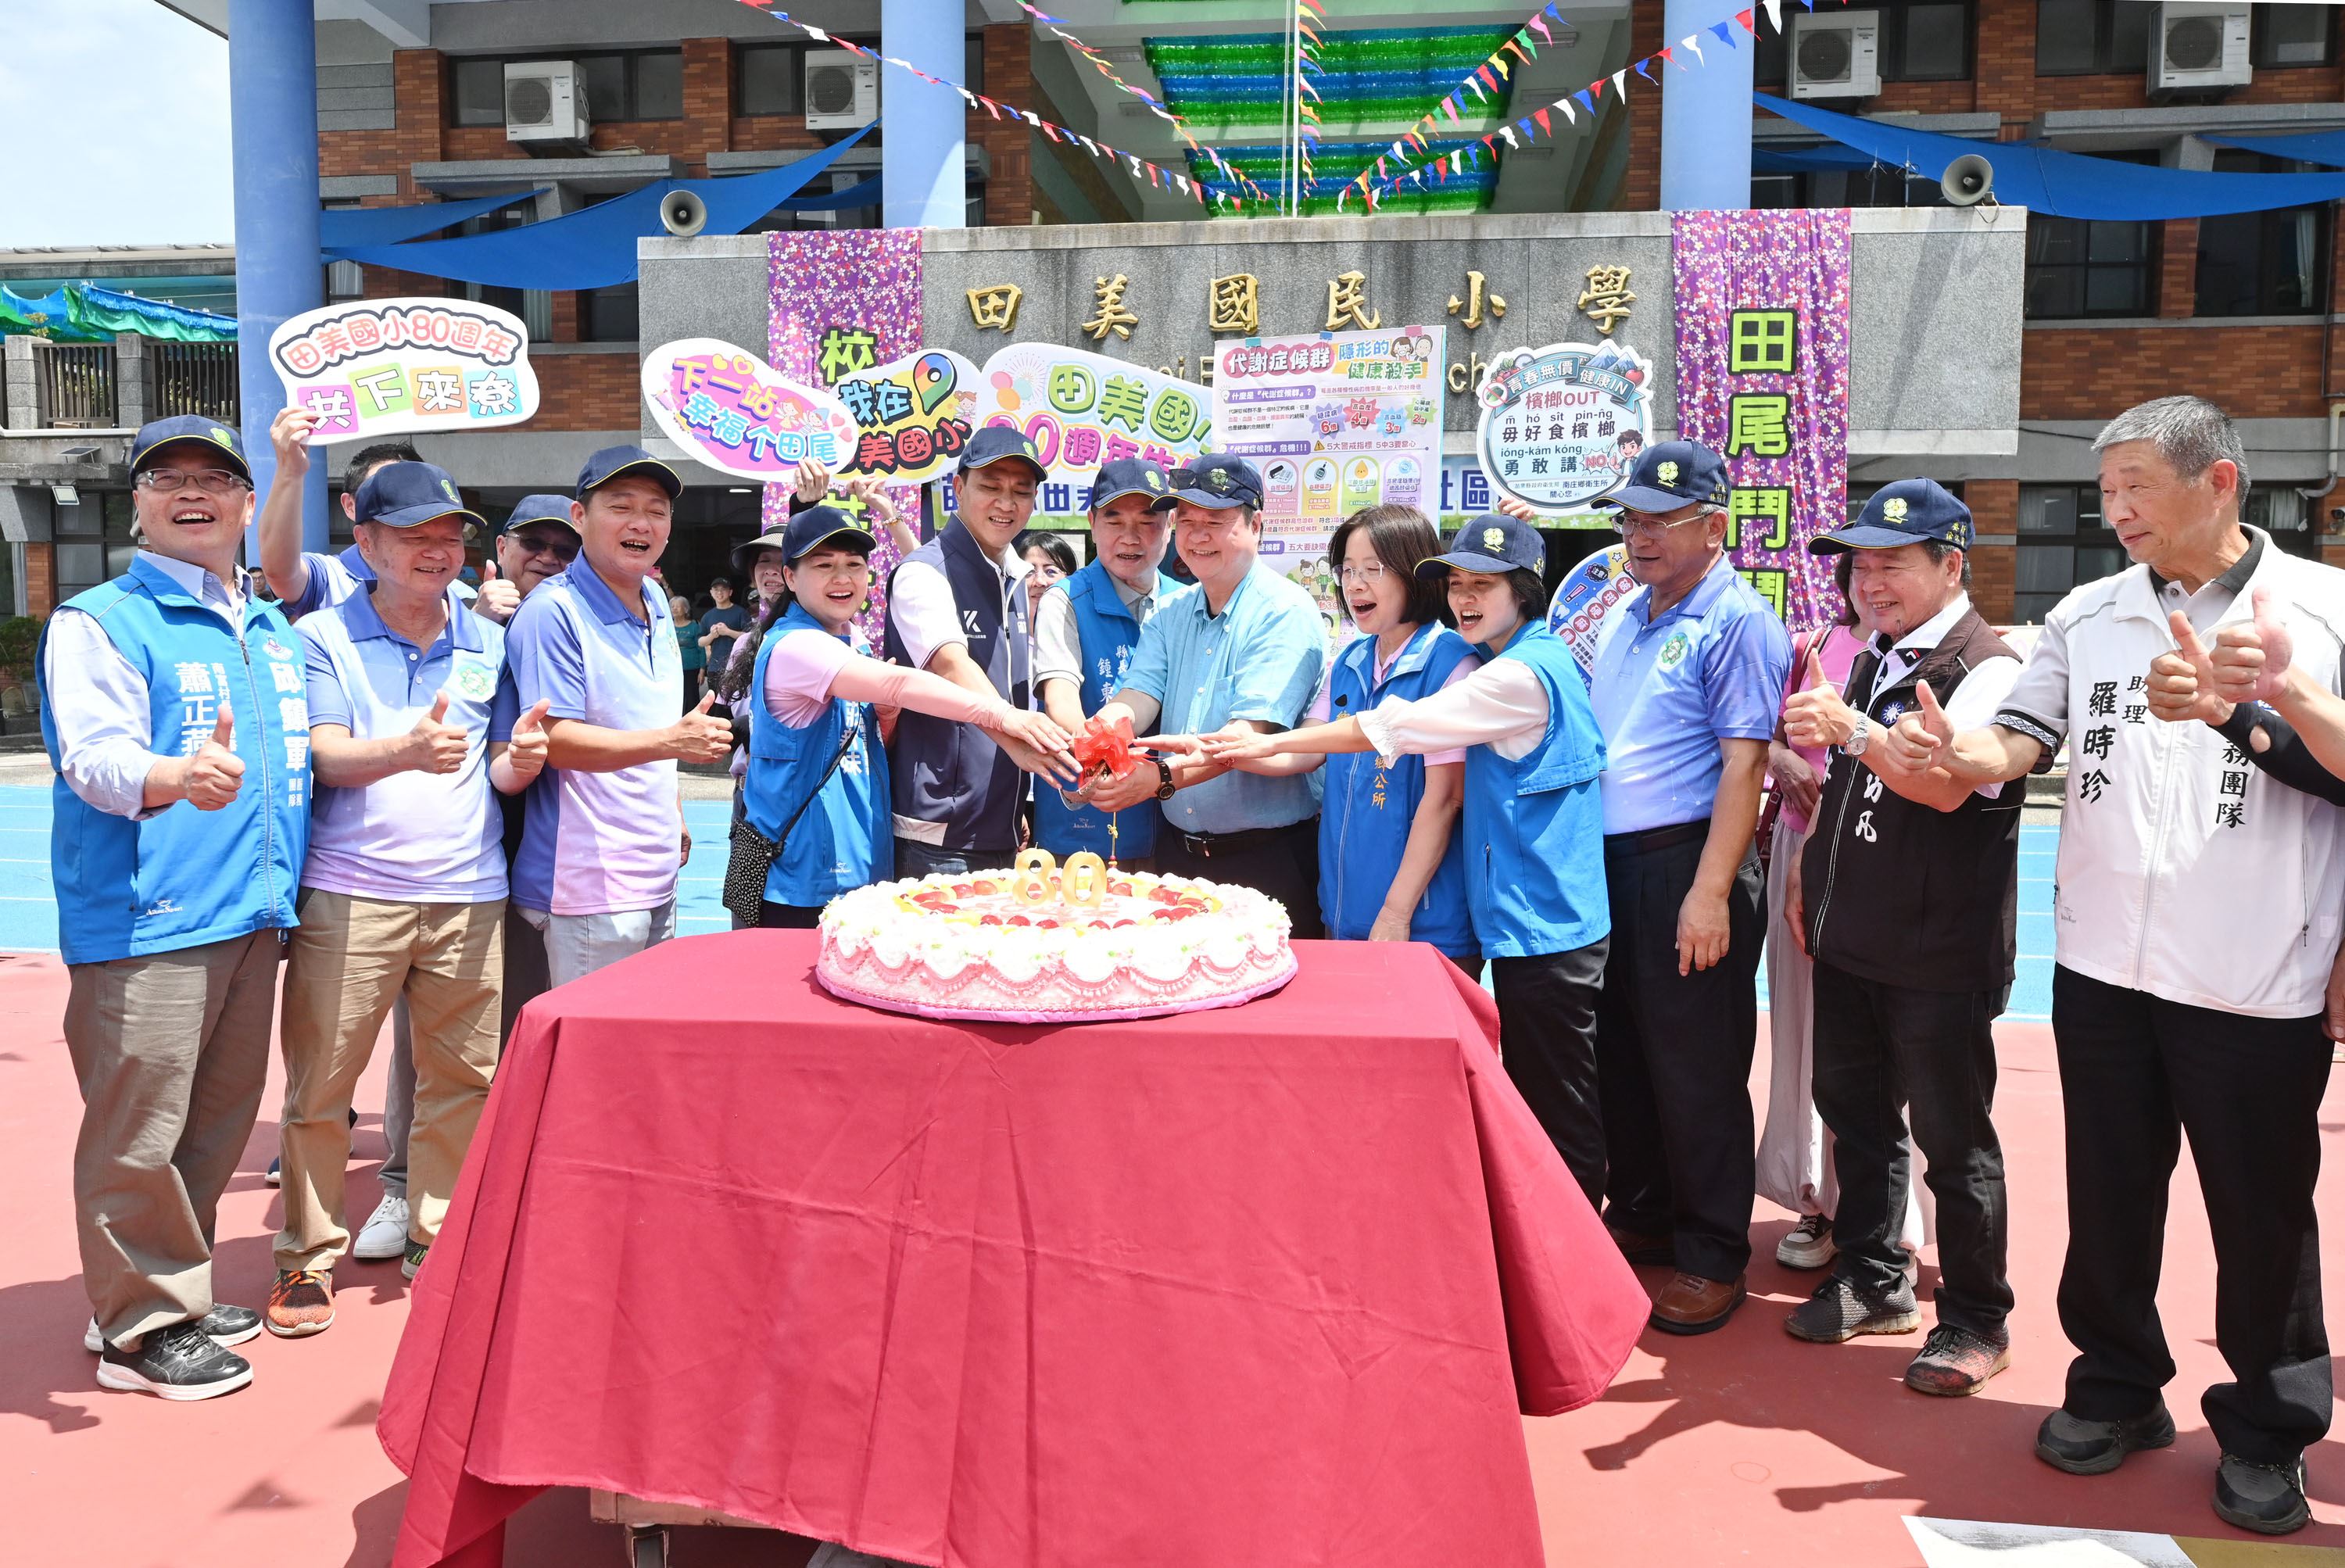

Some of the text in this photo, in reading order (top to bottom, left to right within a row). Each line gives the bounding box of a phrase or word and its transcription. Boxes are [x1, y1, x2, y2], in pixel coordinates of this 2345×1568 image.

[966, 265, 1637, 340] 田美國民小學
[287, 314, 514, 370] 田美國小80週年
[1338, 339, 1390, 361] 隱形的
[1228, 347, 1330, 374] 代謝症候群
[1348, 362, 1423, 380] 健康殺手
[671, 357, 779, 418] 下一站
[1507, 360, 1574, 394] 青春無價
[1580, 369, 1629, 396] 健康IN
[1525, 391, 1601, 410] 檳榔OUT
[850, 420, 973, 473] 美國小
[1584, 454, 1607, 468] NO
[1504, 456, 1577, 476] 勇敢講
[1115, 644, 1128, 674] 縣長
[2121, 675, 2148, 725] 助理
[2079, 680, 2118, 804] 羅時珍
[1011, 847, 1108, 908] 80
